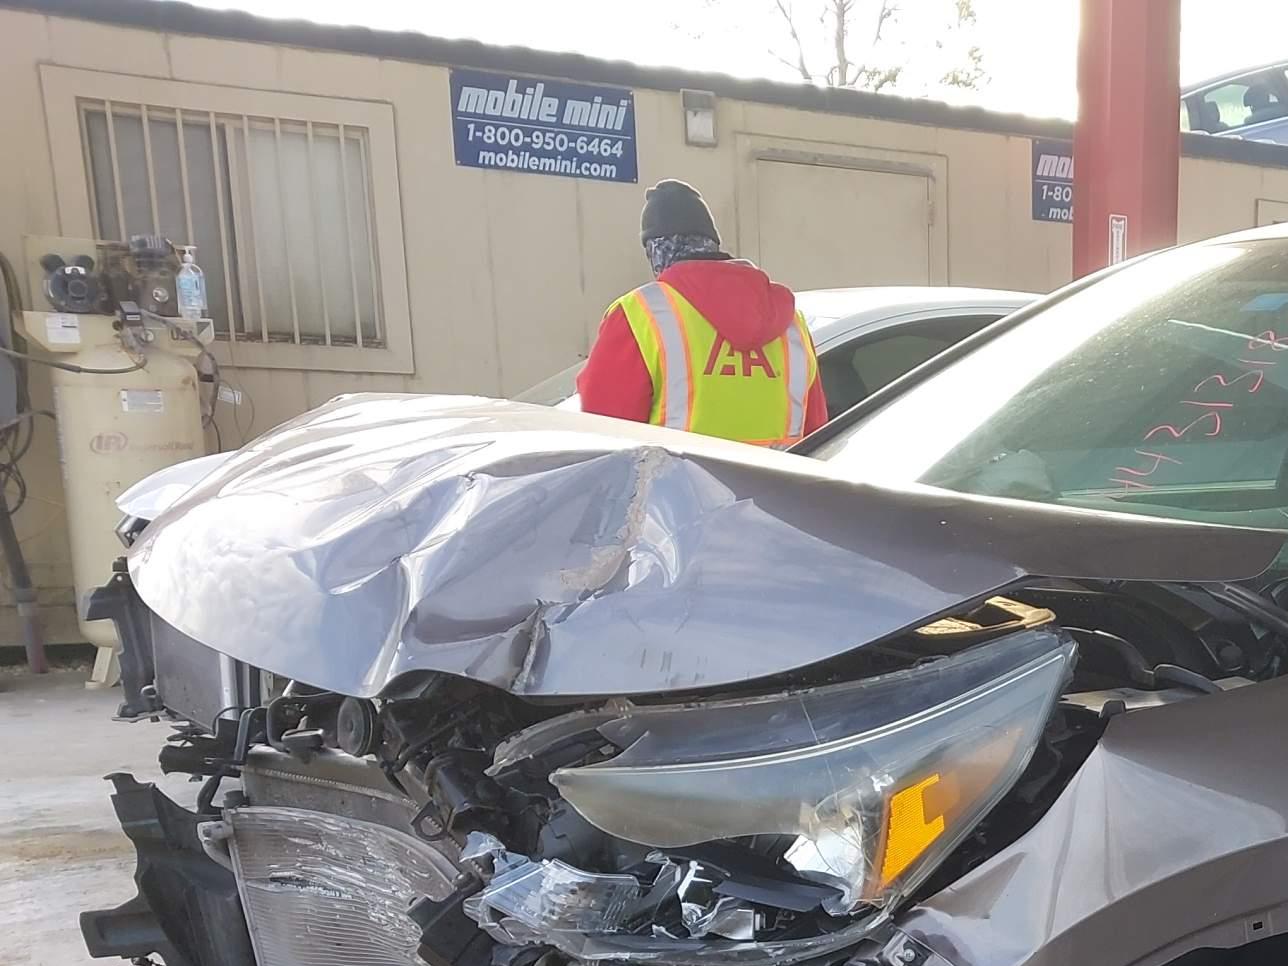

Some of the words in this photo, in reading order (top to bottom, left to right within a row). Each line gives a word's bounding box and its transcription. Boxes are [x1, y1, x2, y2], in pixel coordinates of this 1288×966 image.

[457, 80, 559, 122] mobile
[563, 96, 628, 130] mini
[467, 124, 623, 157] 1-800-950-6464
[478, 150, 617, 178] mobilemini.com
